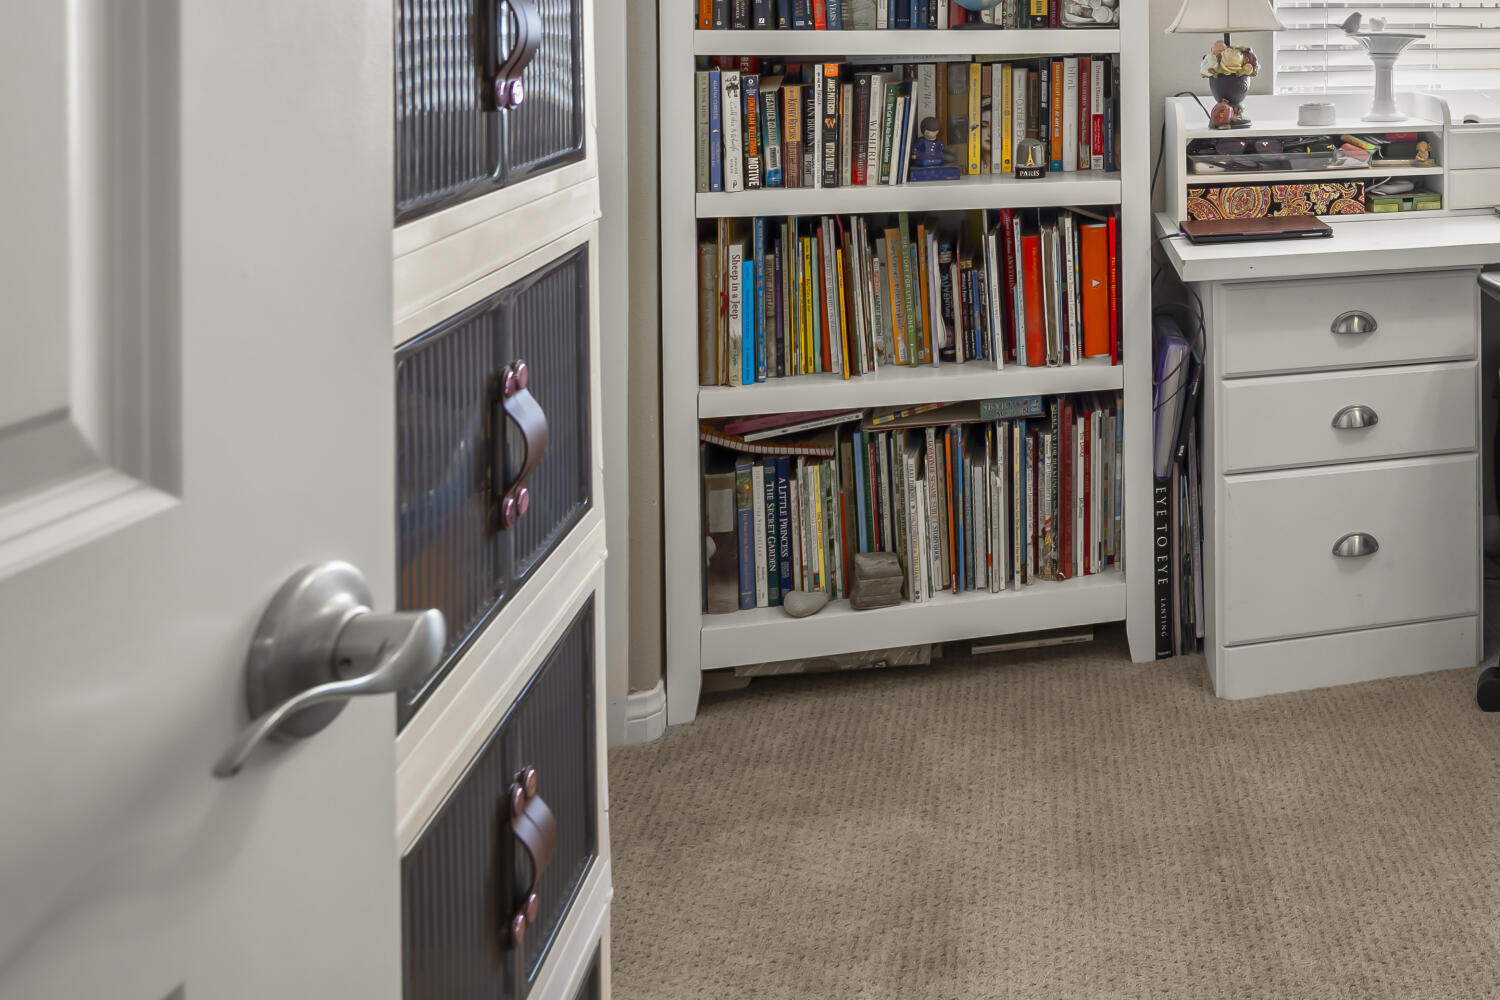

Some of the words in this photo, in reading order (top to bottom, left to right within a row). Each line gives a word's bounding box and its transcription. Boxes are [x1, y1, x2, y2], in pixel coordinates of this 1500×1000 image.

[827, 79, 835, 93] JAMES
[766, 94, 774, 120] HEATHER
[788, 98, 797, 117] KATHY
[767, 122, 775, 146] GRAHAM
[807, 119, 815, 147] BROWN
[868, 120, 877, 168] WISHTREE
[748, 157, 759, 186] MOTIVE
[1015, 167, 1041, 178] PARIS
[731, 254, 740, 280] Sheep
[732, 283, 739, 291] in
[731, 300, 740, 319] Jeep
[766, 482, 775, 500] THE
[779, 486, 787, 515] LITTLE
[929, 475, 937, 500] SESAME
[1155, 487, 1167, 517] EYE
[767, 503, 775, 534] SECRET
[780, 518, 789, 558] PRINCESS
[1157, 523, 1167, 547] TO
[768, 536, 776, 572] GARDEN
[1157, 555, 1169, 585] EYE
